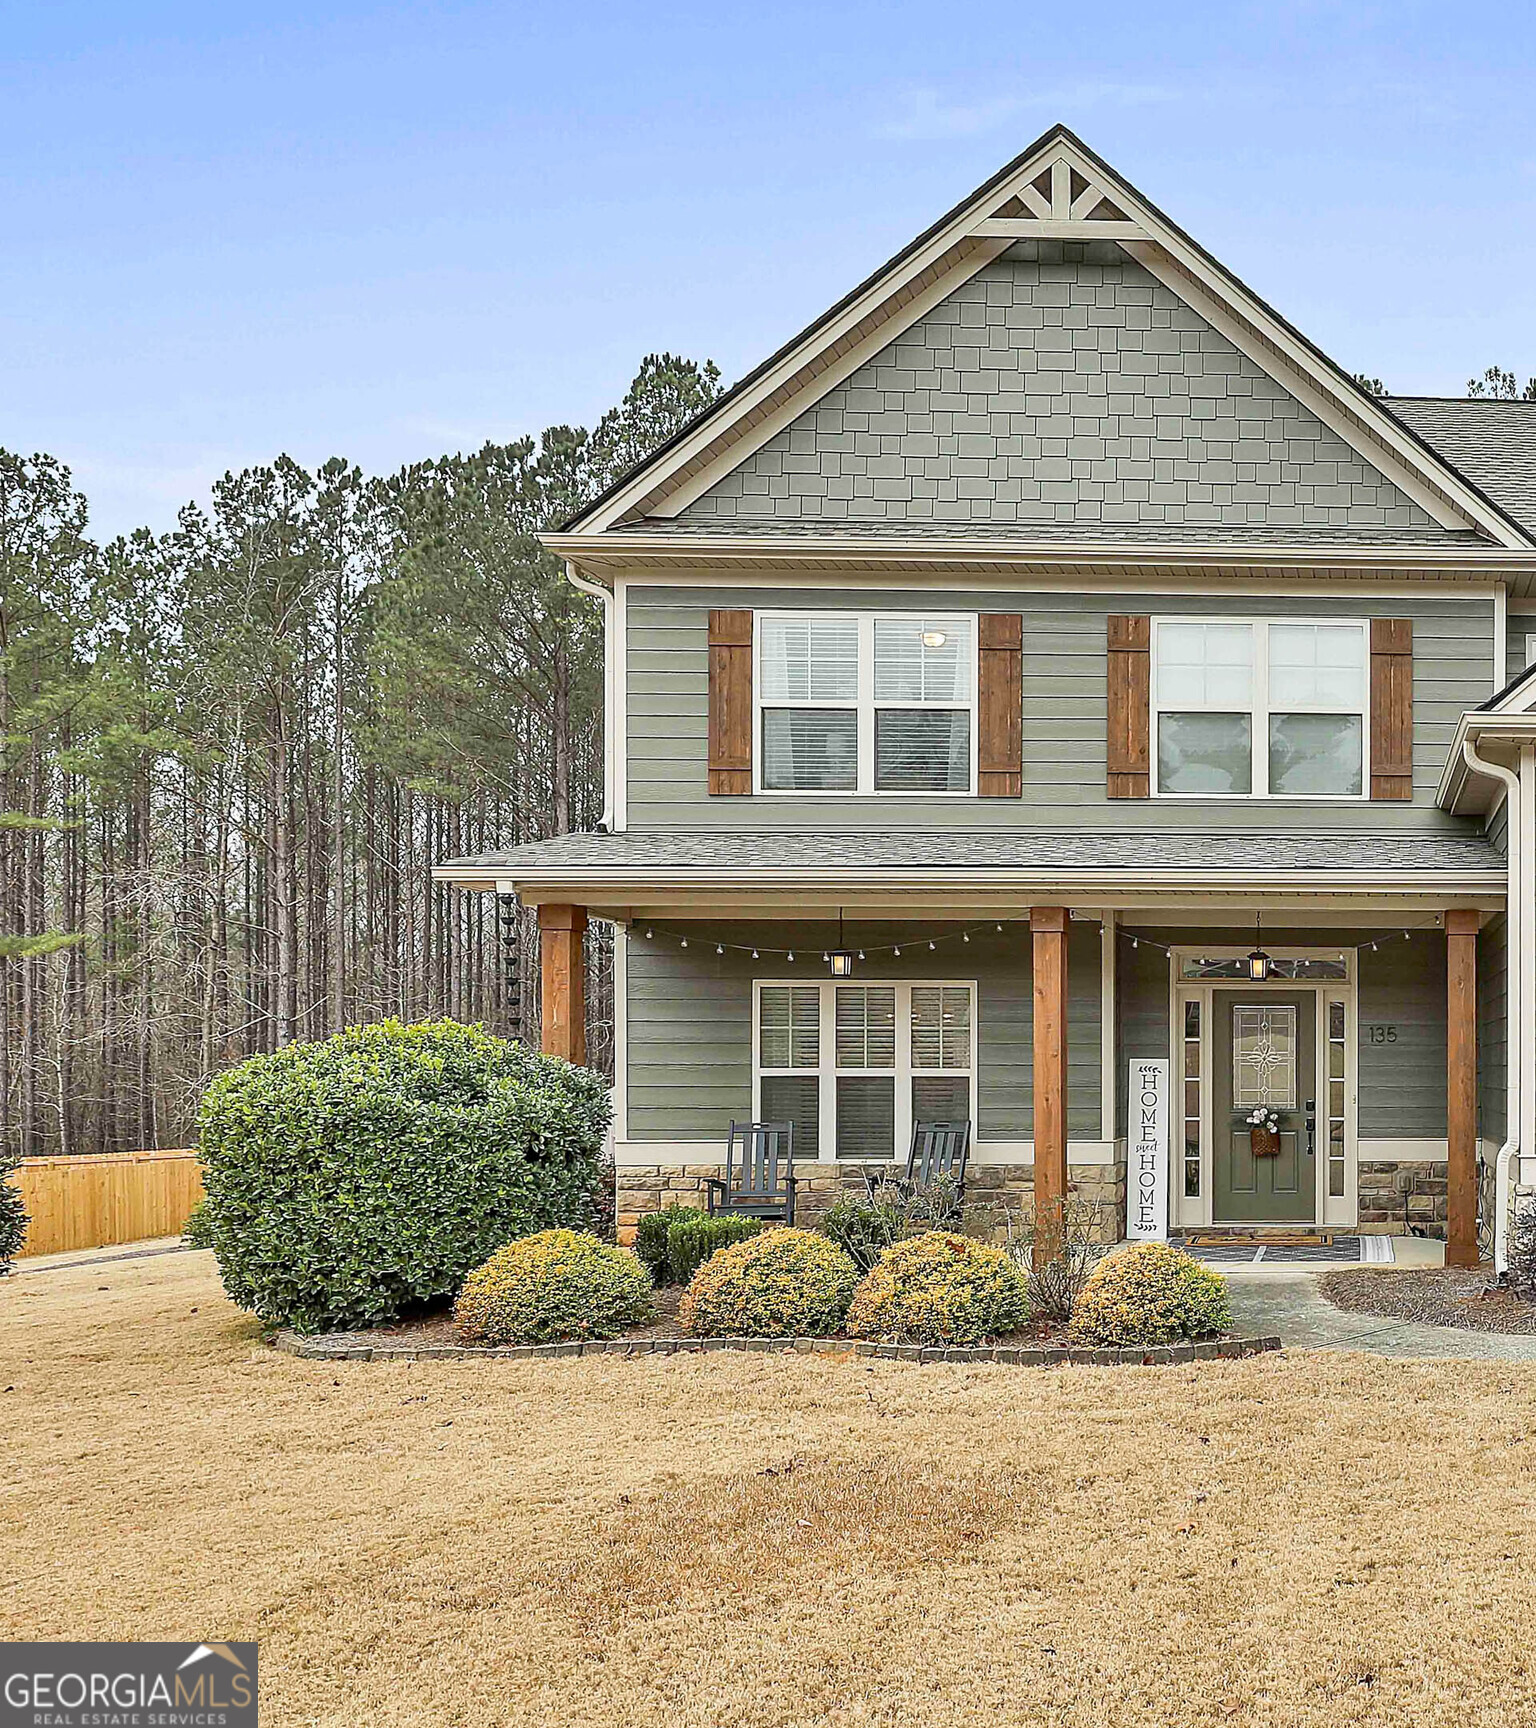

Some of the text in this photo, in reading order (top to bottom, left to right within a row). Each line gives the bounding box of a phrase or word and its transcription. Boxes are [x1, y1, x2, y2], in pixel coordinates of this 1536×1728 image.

[1369, 1026, 1397, 1043] 135
[1140, 1074, 1158, 1142] HOME
[1135, 1140, 1161, 1154] sweet
[1138, 1154, 1157, 1223] HOME
